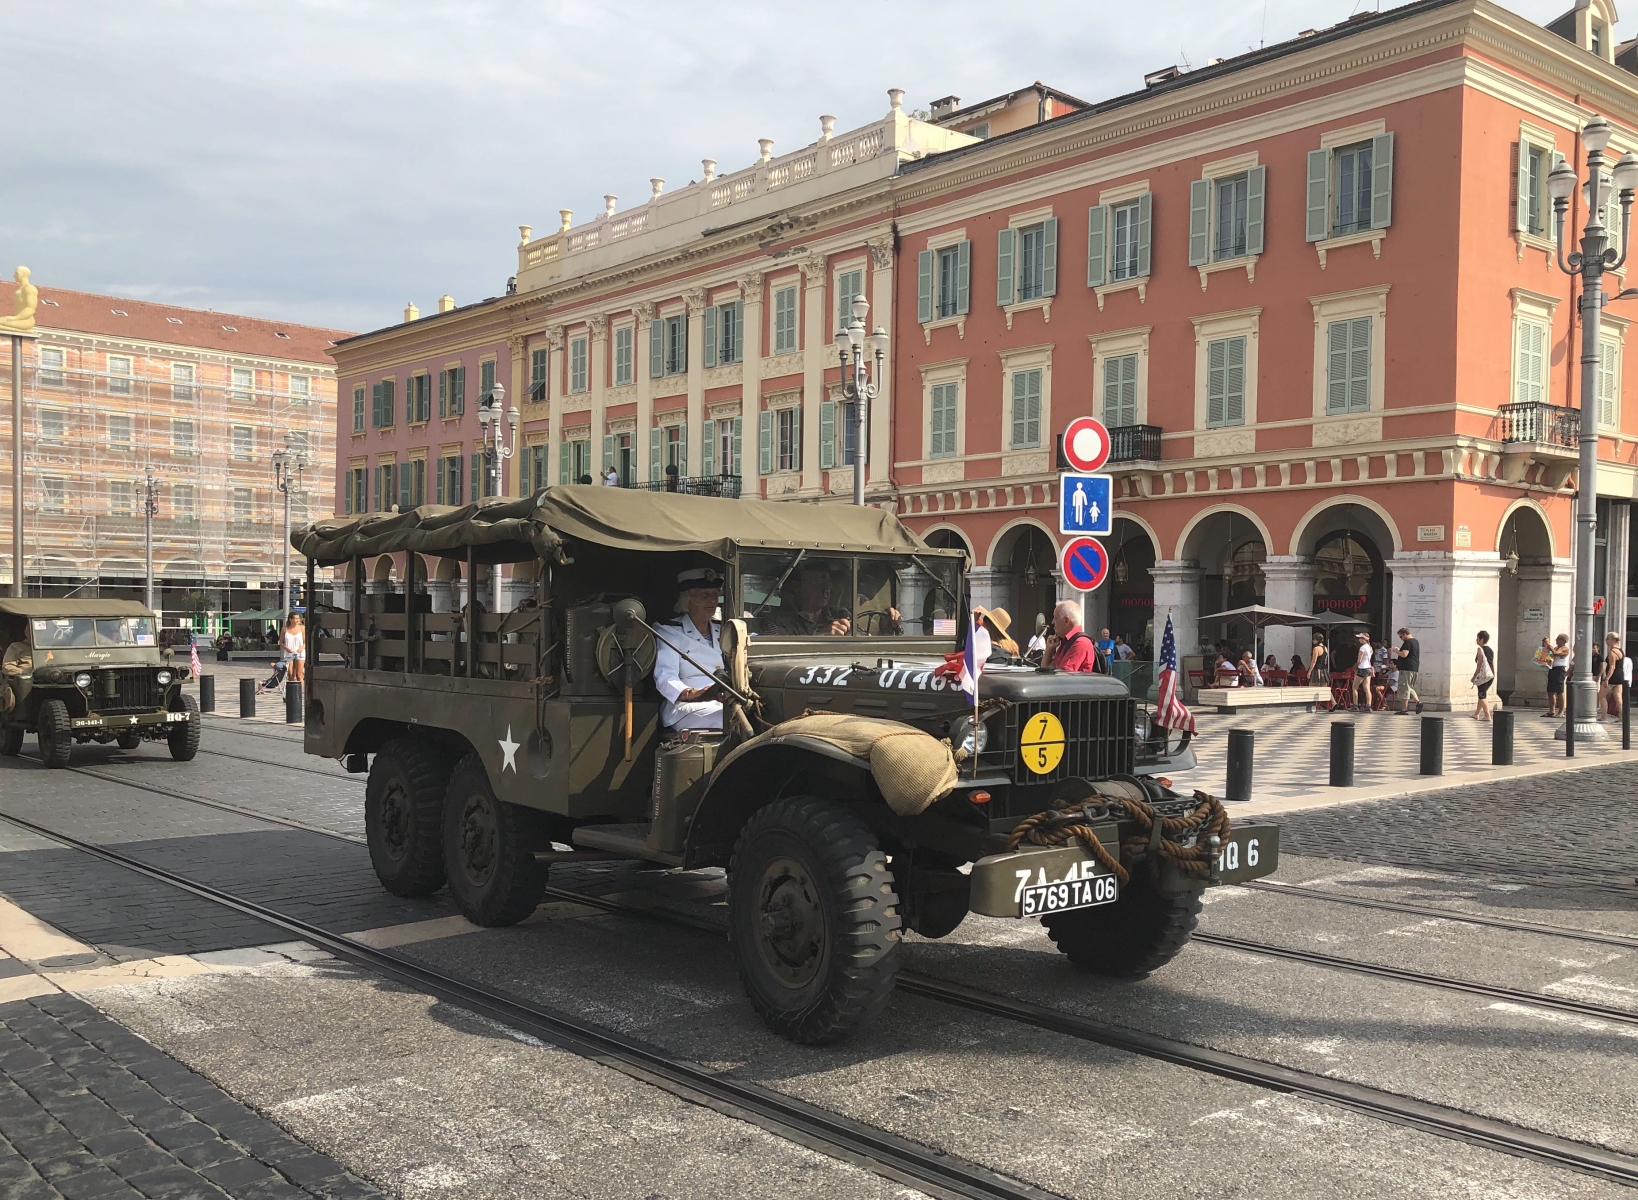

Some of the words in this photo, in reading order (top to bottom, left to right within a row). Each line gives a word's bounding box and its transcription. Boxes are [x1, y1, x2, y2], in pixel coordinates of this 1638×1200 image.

[85, 651, 111, 660] Margie
[800, 665, 853, 686] 332
[166, 712, 190, 722] HQ-7
[1039, 719, 1048, 740] 7
[1038, 747, 1047, 768] 5
[1247, 838, 1259, 867] 6
[1024, 884, 1069, 913] 5769
[1072, 880, 1092, 905] TA
[1095, 877, 1115, 901] 06
